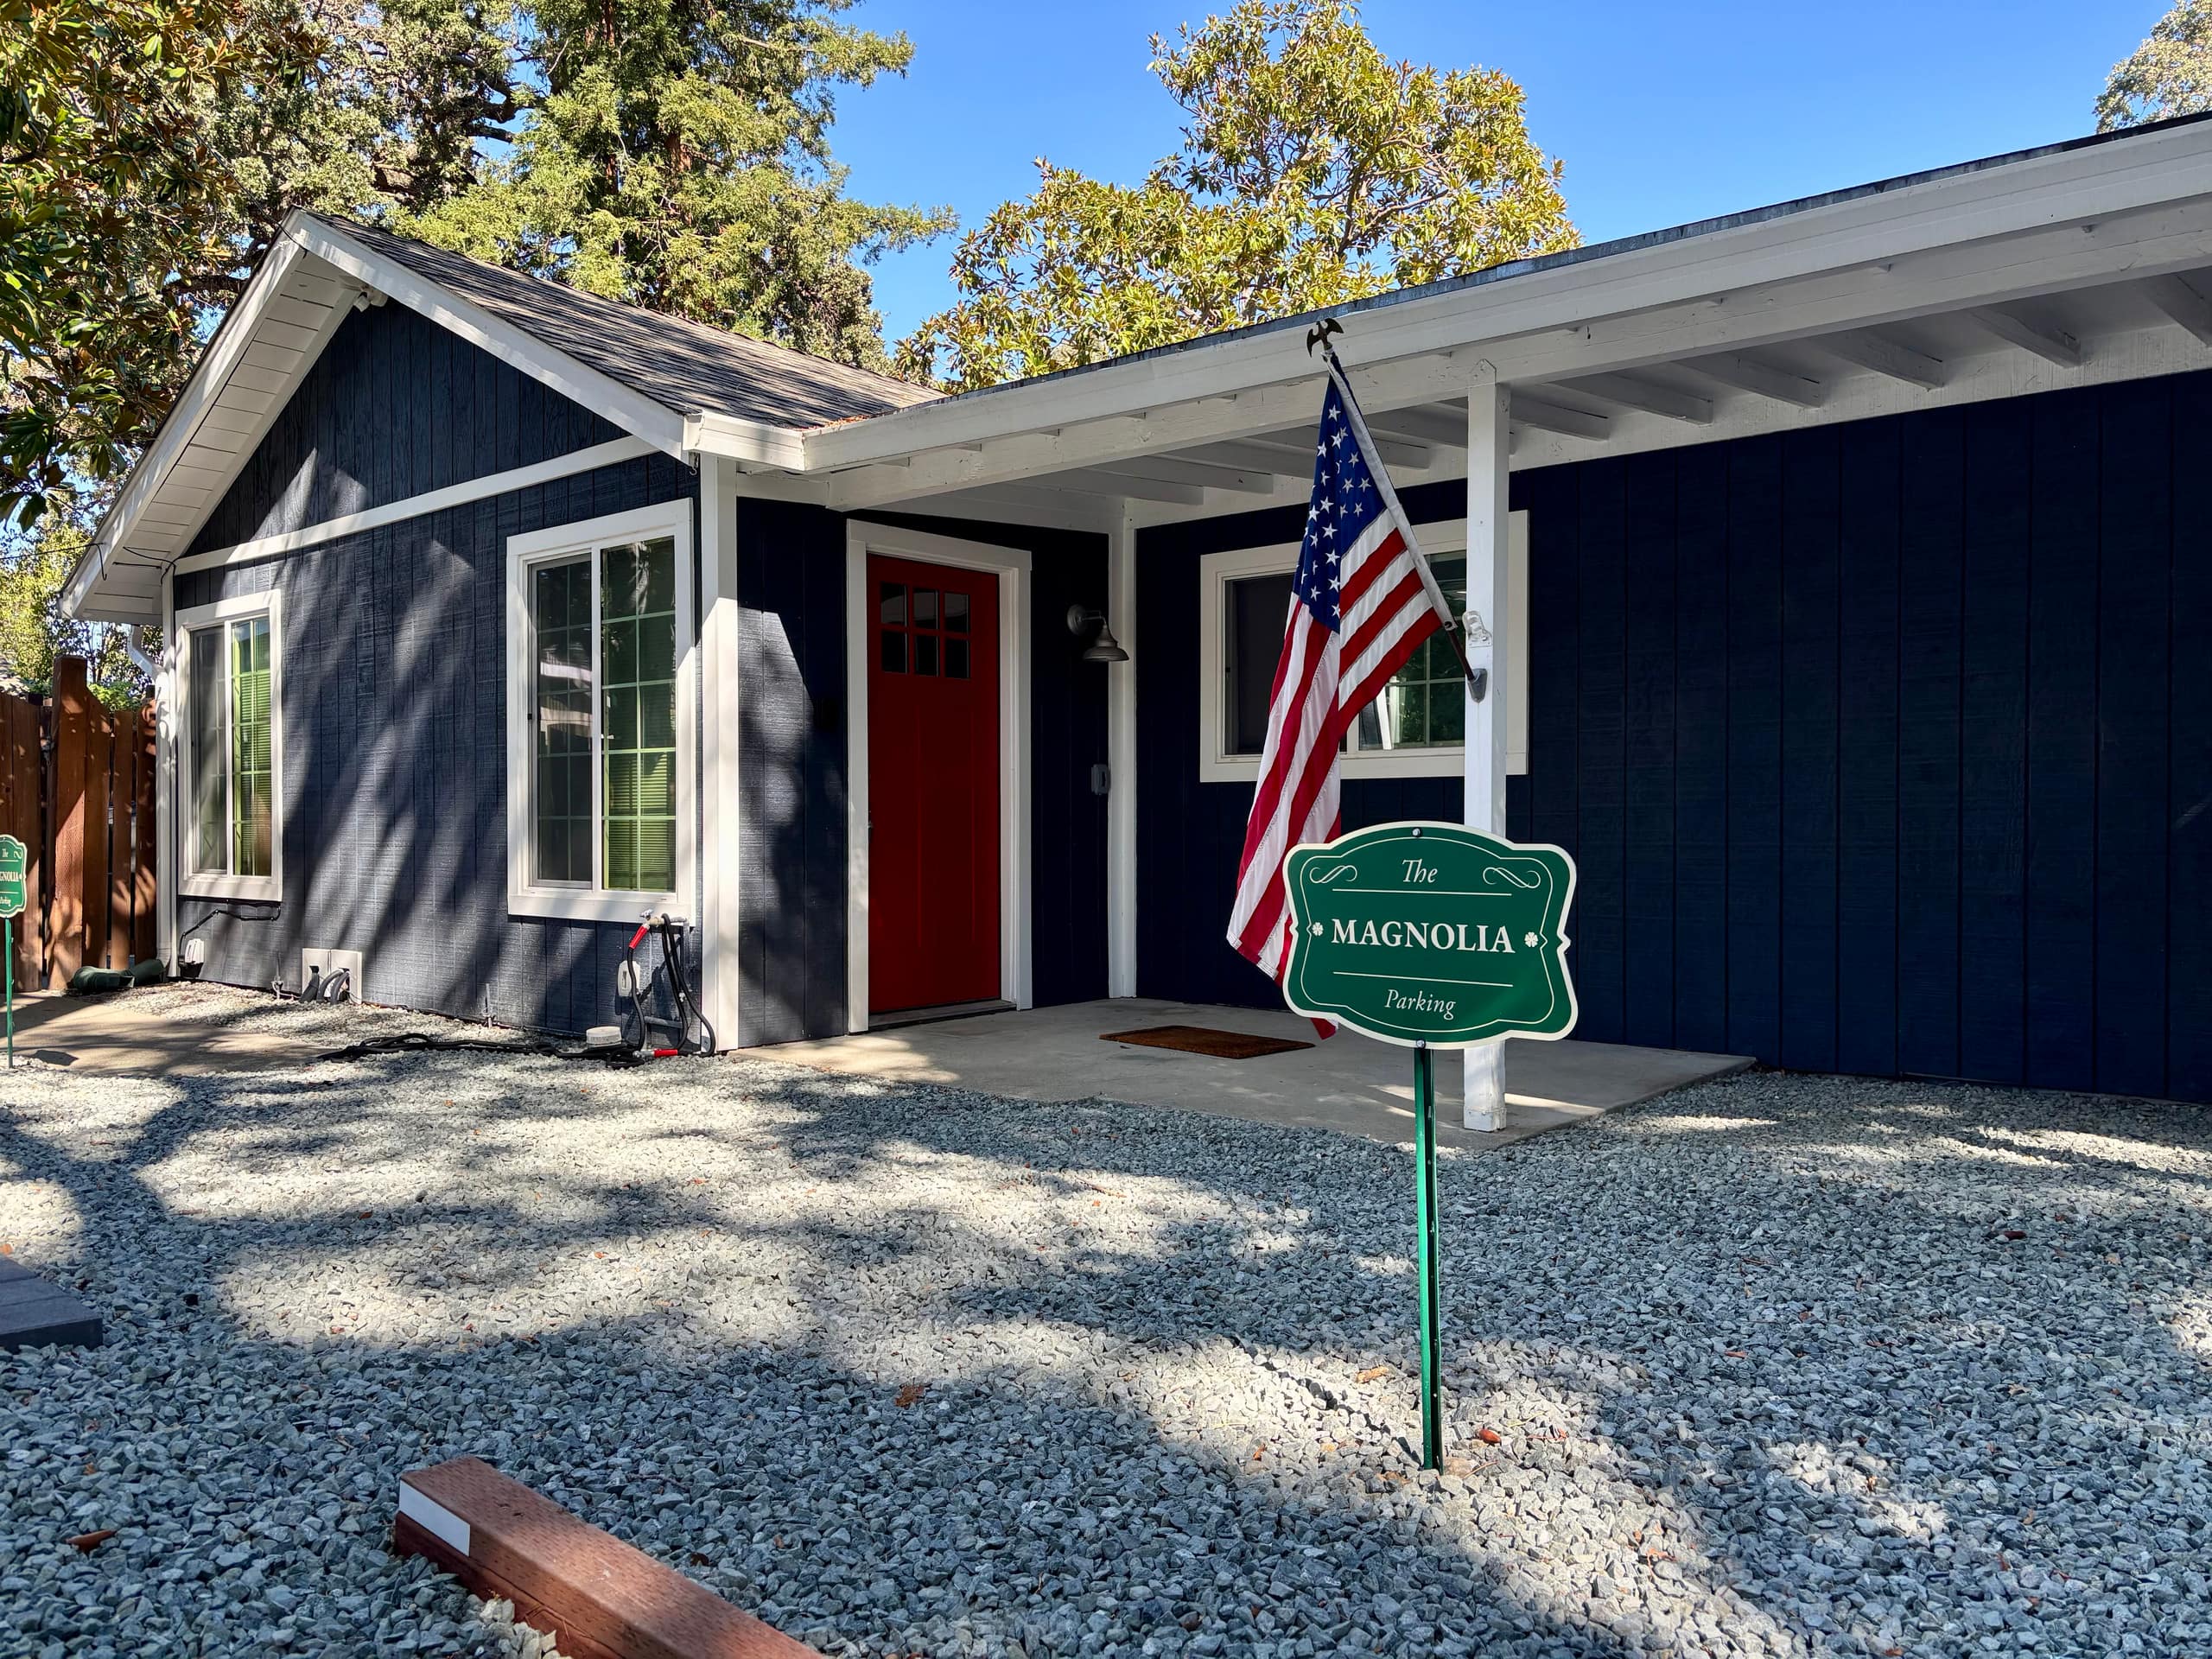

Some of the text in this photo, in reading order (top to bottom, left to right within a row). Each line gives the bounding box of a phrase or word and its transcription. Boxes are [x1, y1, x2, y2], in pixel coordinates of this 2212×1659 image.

[1402, 858, 1438, 883] The
[1332, 918, 1516, 953] MAGNOLIA
[1384, 989, 1456, 1020] Parking
